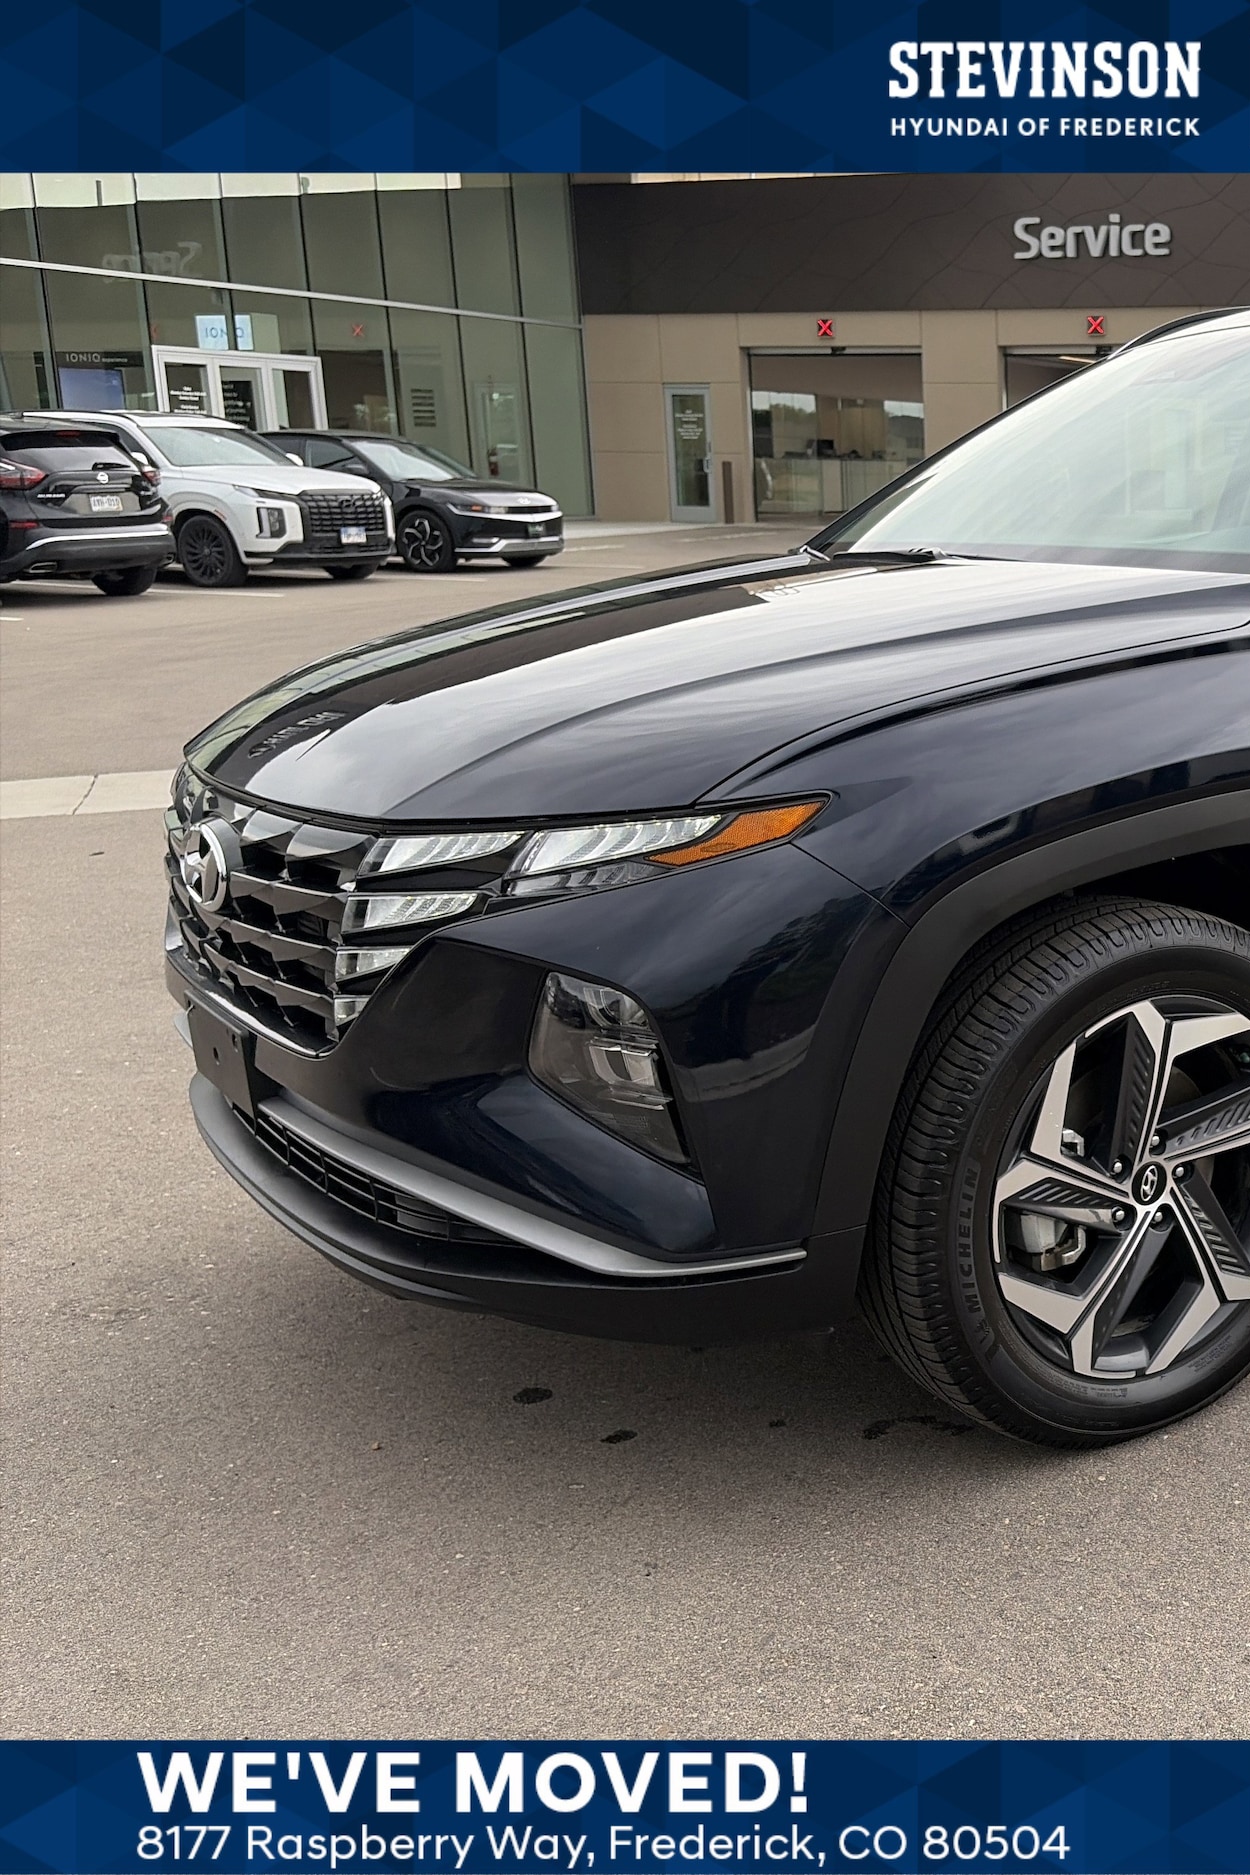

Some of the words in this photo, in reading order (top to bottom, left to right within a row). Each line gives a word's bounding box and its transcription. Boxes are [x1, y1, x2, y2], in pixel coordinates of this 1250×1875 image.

[1014, 213, 1172, 259] Service
[204, 326, 245, 340] IONQ
[65, 353, 101, 364] IONIQ
[957, 1167, 983, 1315] MICHELIN
